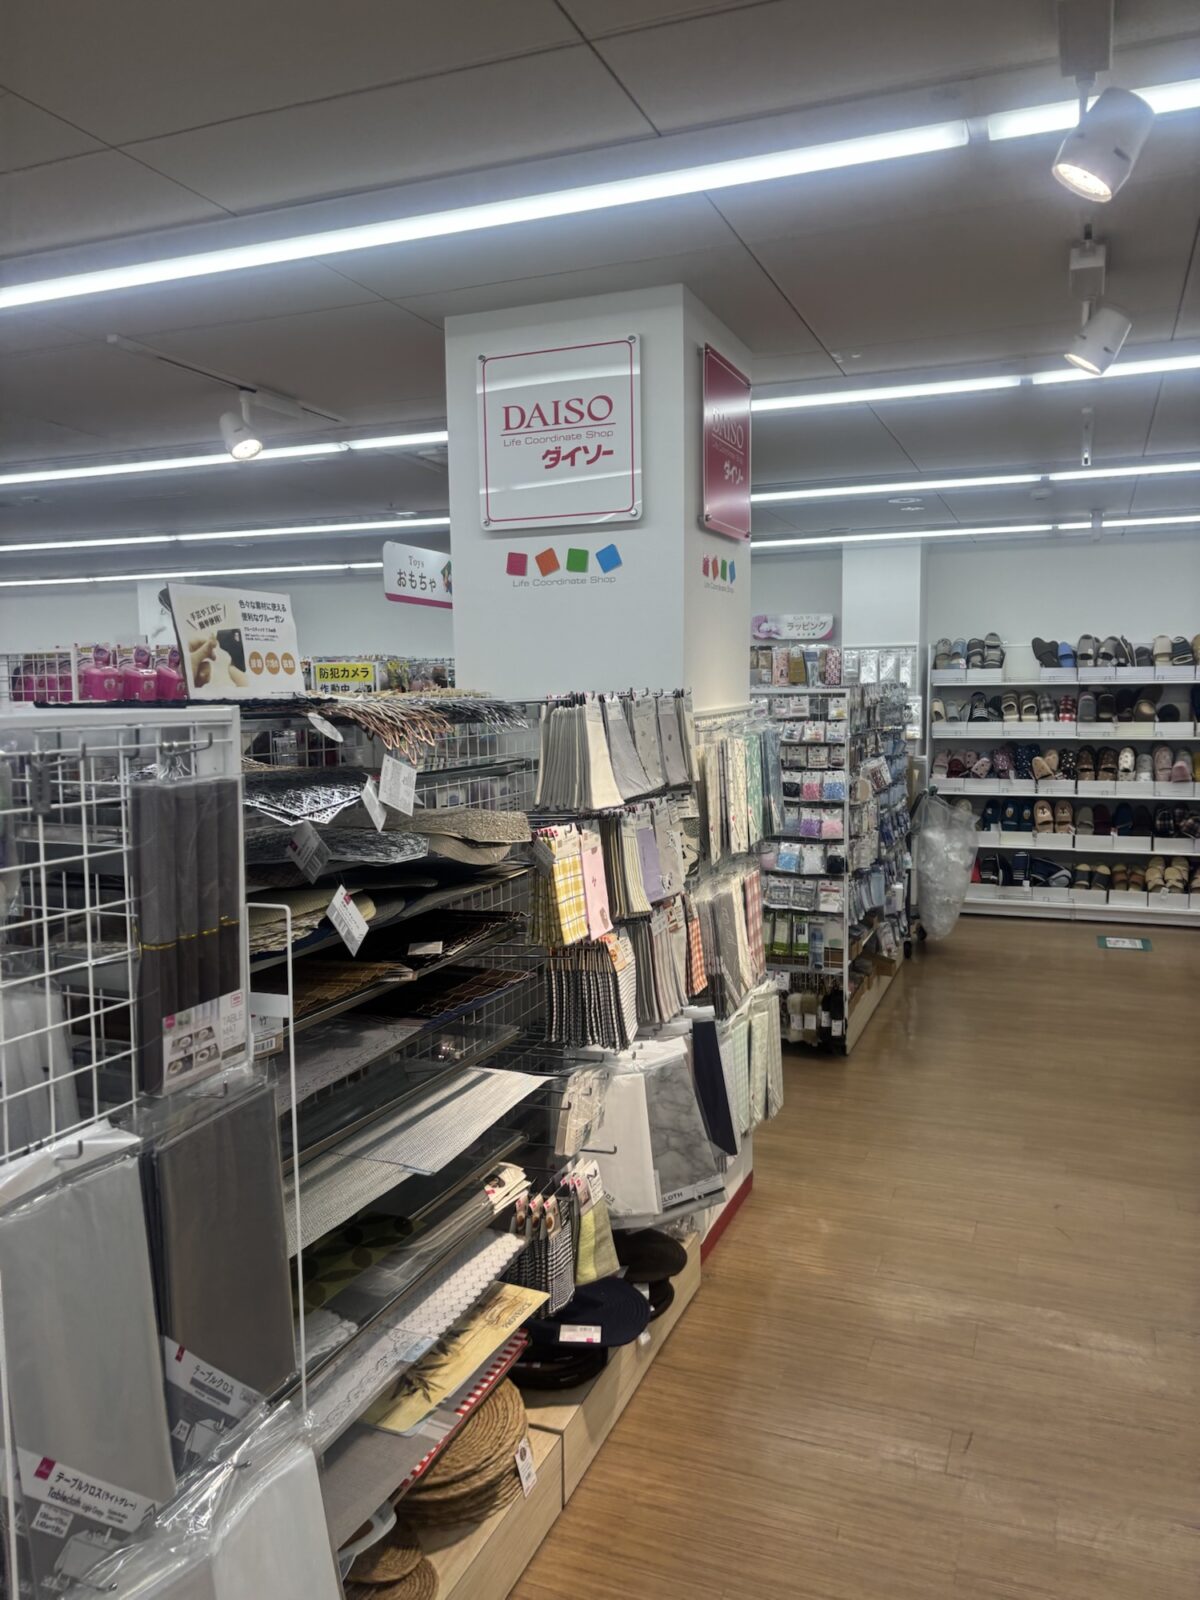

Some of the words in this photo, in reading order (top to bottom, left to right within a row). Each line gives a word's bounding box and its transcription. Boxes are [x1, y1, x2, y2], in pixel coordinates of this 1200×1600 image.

[502, 395, 613, 431] DAISO
[503, 439, 521, 447] Life
[525, 431, 582, 445] Coordinate
[586, 430, 614, 439] Shop
[541, 444, 614, 469] ダイソー
[408, 555, 425, 569] Toys
[396, 568, 437, 593] おもちゃ
[512, 579, 530, 588] Life
[532, 578, 587, 587] Coordinate
[590, 576, 616, 584] Shop
[241, 612, 285, 624] 便利なグルーガン
[787, 621, 828, 631] ラッピング
[319, 667, 369, 679] 防犯カメラ
[661, 1191, 683, 1202] LOTH
[193, 1364, 235, 1397] テーブルクロス
[55, 1471, 138, 1512] テーブルクロス(ライトグレー)
